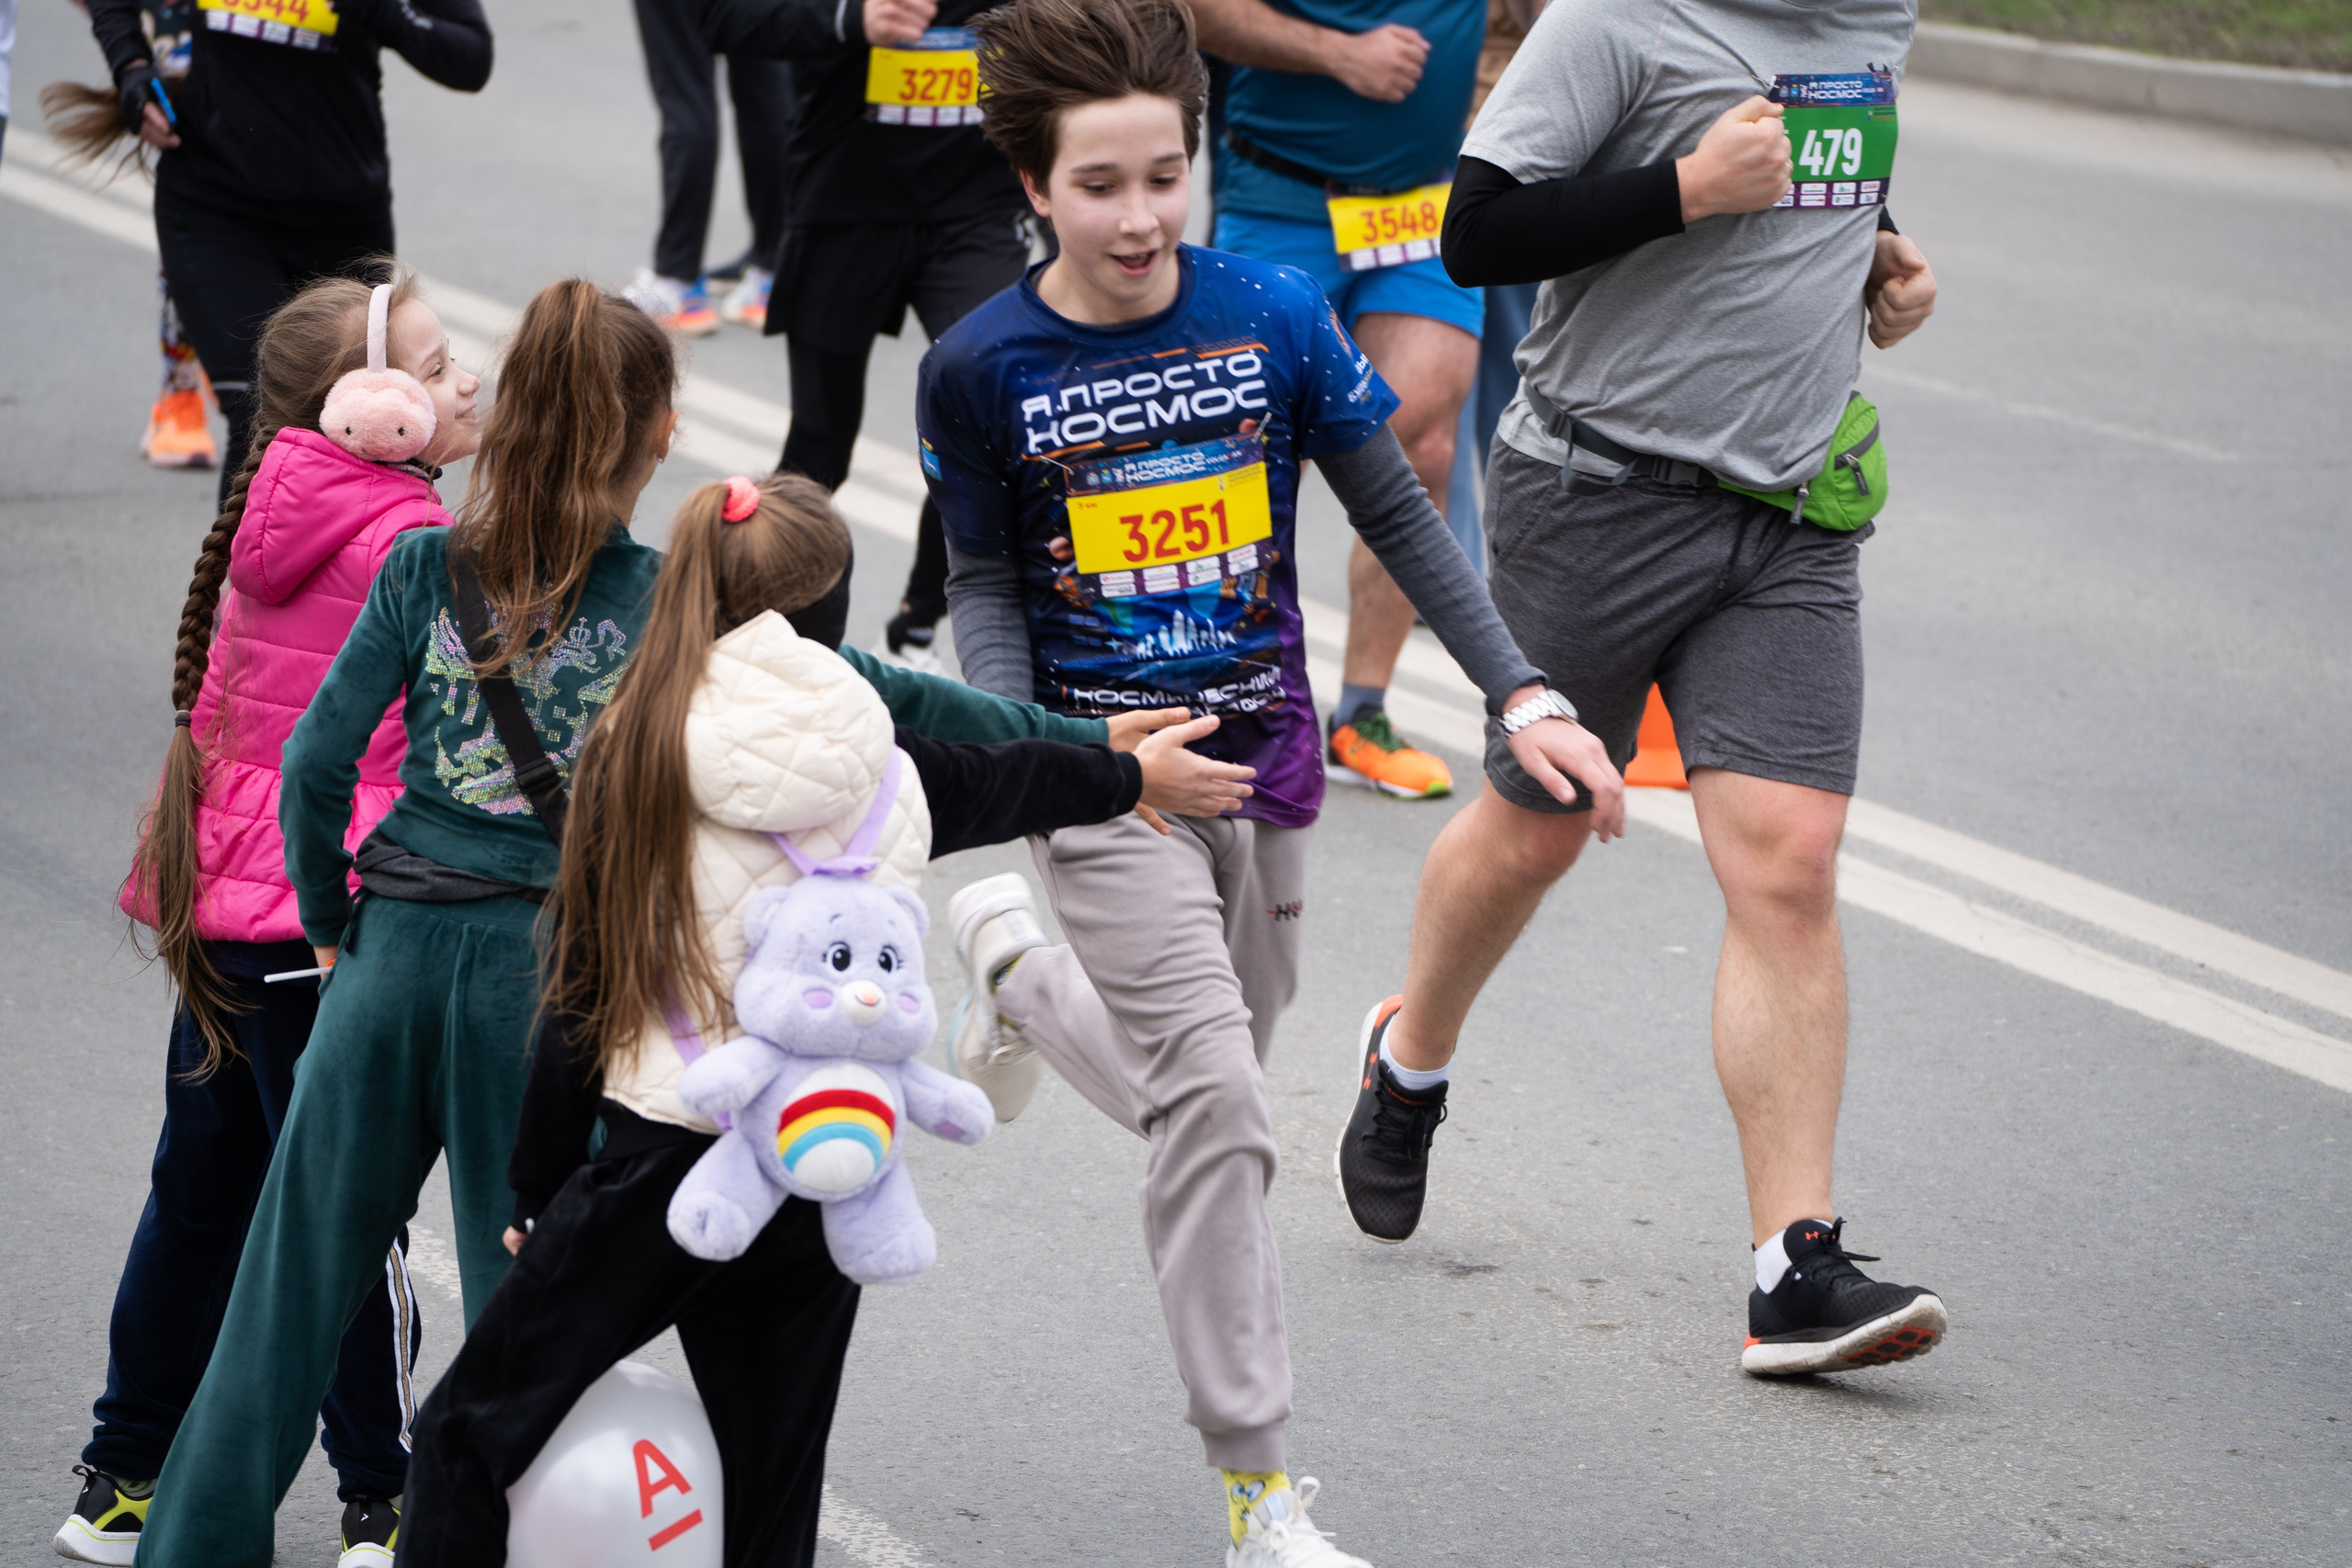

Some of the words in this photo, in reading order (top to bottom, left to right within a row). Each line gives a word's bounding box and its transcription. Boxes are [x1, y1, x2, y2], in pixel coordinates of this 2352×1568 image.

[899, 68, 973, 101] 3279
[1819, 81, 1862, 89] ПРОСТО
[1799, 128, 1862, 175] 479
[1361, 202, 1438, 243] 3548
[1022, 394, 1052, 423] Я
[1059, 352, 1262, 412] ПРОСТО
[1025, 379, 1269, 454] КОСМОС
[1119, 499, 1230, 562] 3251
